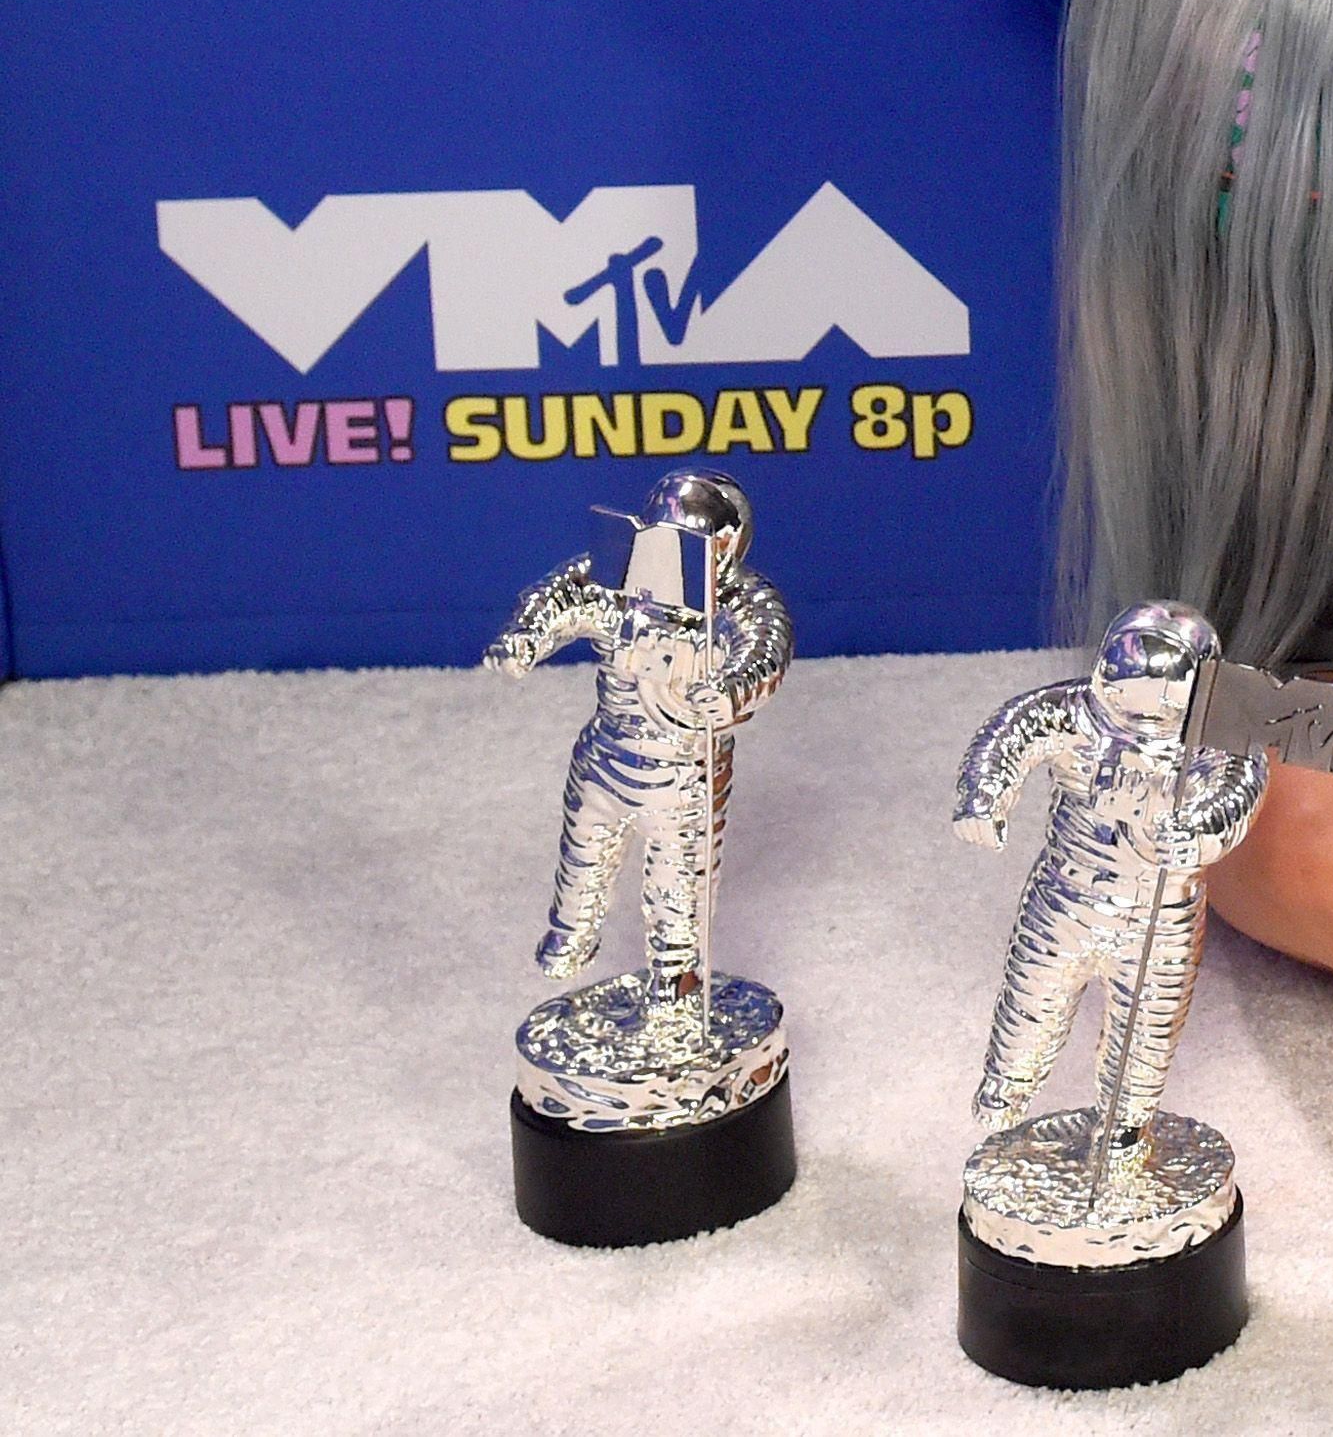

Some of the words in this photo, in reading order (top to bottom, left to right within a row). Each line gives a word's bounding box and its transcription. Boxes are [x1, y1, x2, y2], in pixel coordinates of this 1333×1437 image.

[156, 181, 971, 375] VMA
[174, 397, 414, 472] LIVE!
[443, 387, 824, 464] SUNDAY
[849, 383, 975, 460] 8p
